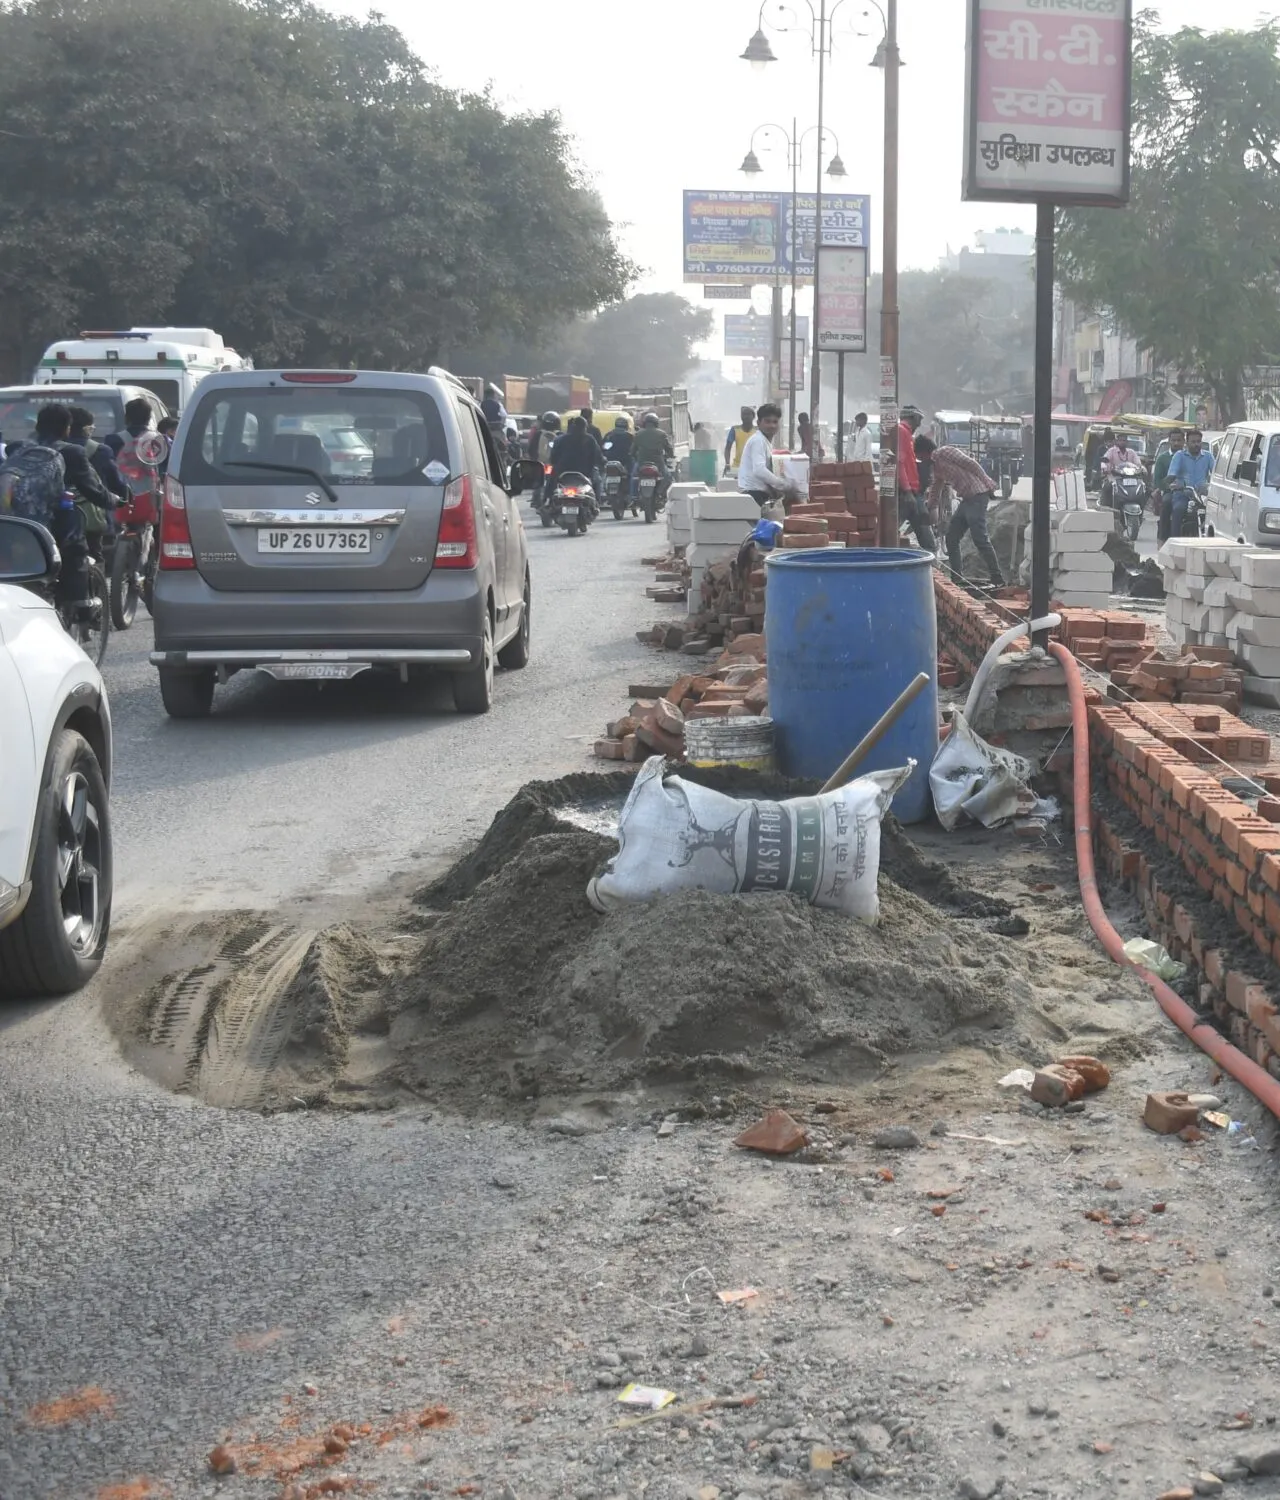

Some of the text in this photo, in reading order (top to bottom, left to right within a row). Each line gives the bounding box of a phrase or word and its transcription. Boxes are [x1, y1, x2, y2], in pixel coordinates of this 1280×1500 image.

[983, 19, 1117, 66] सी.टी.
[992, 77, 1106, 122] स्कैन
[980, 133, 1116, 171] सुविधा उपलब्ध
[787, 195, 831, 209] ऑपरेन
[791, 211, 858, 227] वासीर
[269, 532, 368, 549] UP 26 U 7362
[283, 664, 349, 677] WAGON-R
[752, 801, 781, 893] OCKSTRON
[831, 842, 849, 864] को
